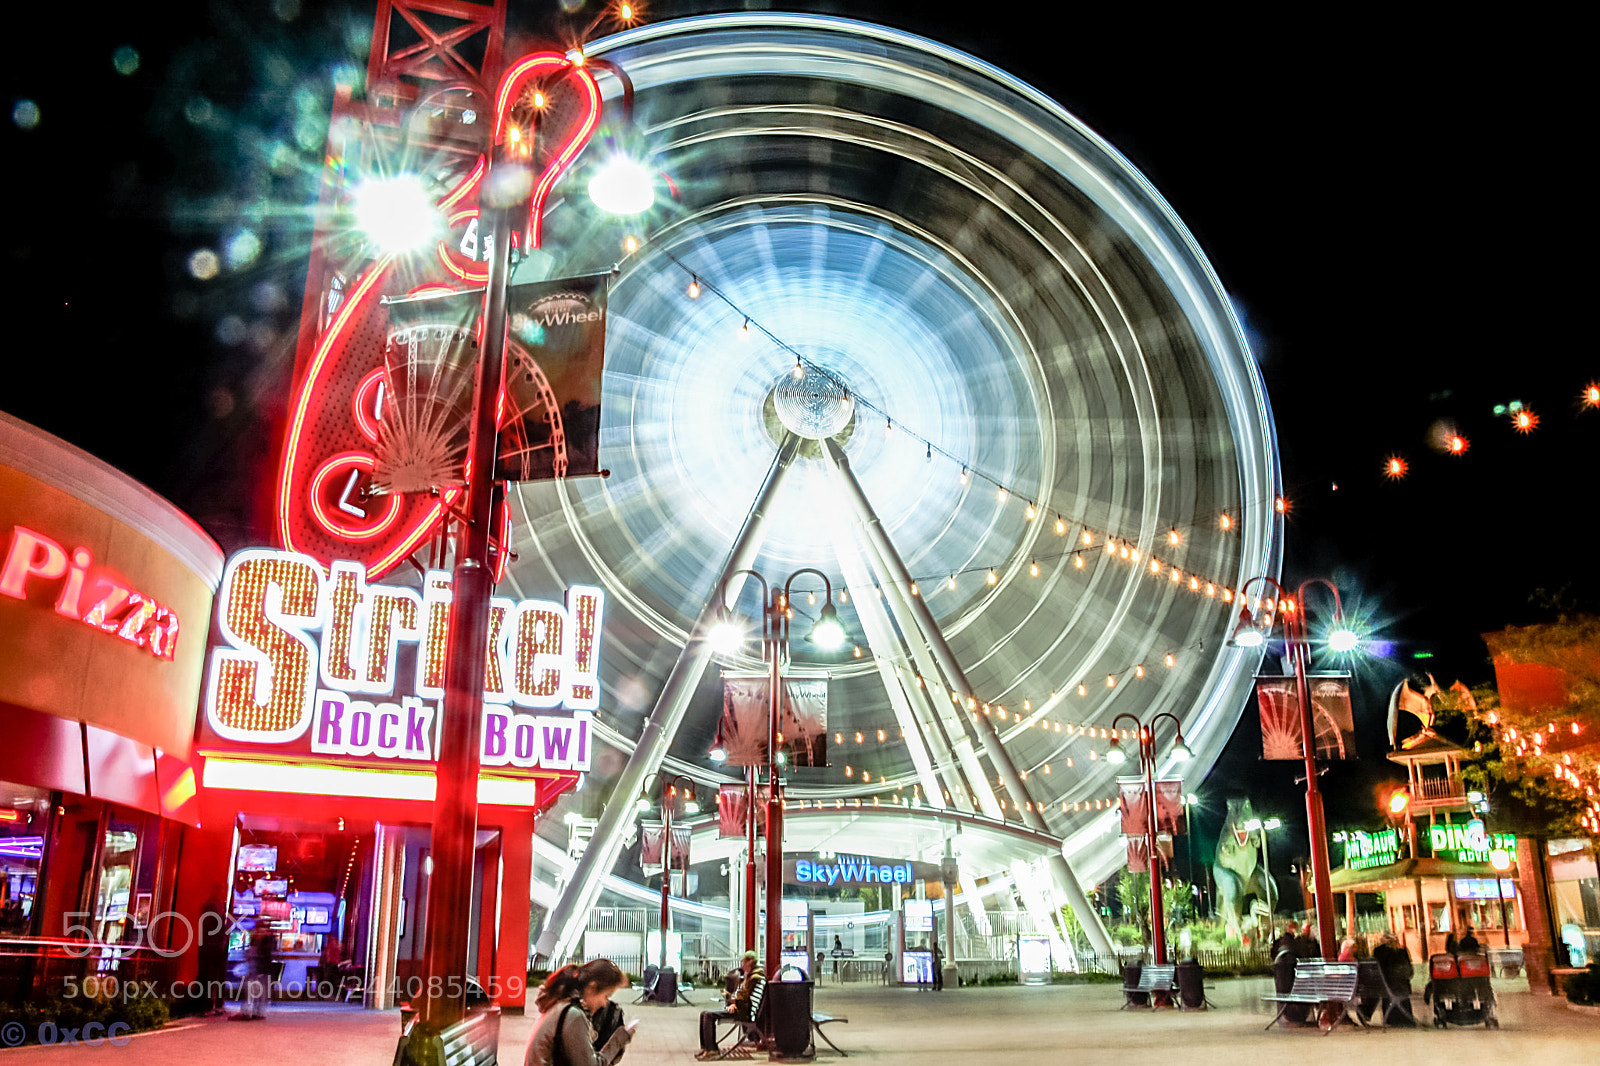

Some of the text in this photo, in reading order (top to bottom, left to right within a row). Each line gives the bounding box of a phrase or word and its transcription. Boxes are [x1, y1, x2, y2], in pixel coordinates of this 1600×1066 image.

[0, 525, 180, 662] Pizza
[314, 693, 593, 769] Rock Bowl
[795, 858, 913, 886] SkyWheel
